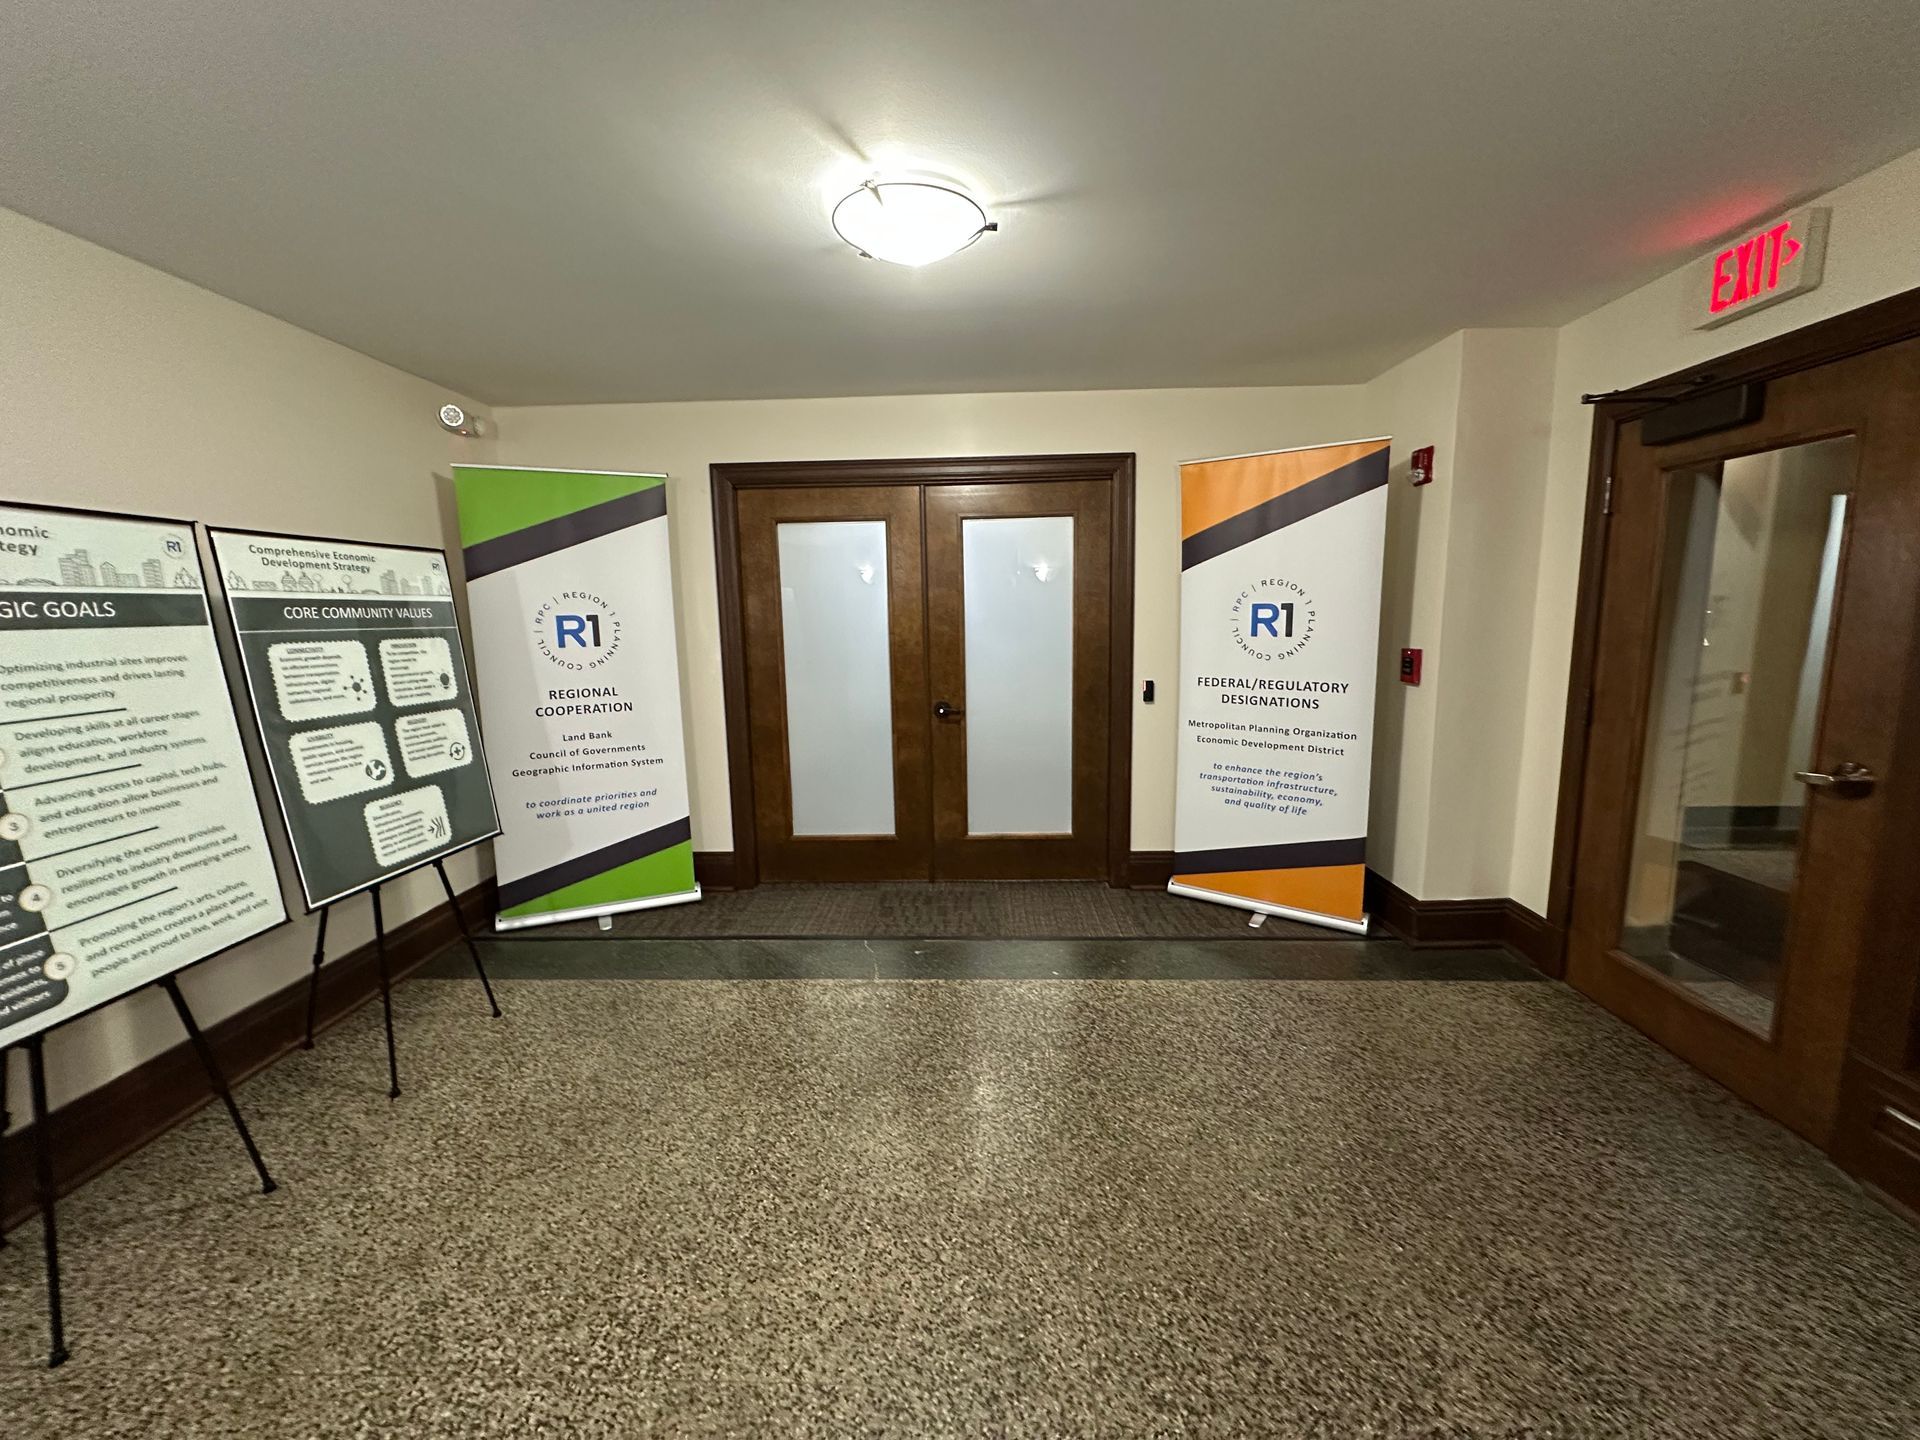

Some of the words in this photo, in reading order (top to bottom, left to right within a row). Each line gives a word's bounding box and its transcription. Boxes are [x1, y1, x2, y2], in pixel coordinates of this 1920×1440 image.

[1709, 220, 1791, 314] EXIT
[249, 544, 330, 560] Comprehensive
[333, 552, 376, 563] Economic
[261, 557, 331, 571] Development
[334, 562, 370, 574] Strategy
[1261, 578, 1305, 596] REGION
[0, 601, 38, 618] GIC
[43, 601, 116, 617] GOALS
[563, 592, 608, 609] REGION
[1232, 591, 1248, 612] RPC
[284, 607, 318, 619] CORE
[322, 607, 393, 619] COMMUNITY
[397, 607, 433, 618] VALUES
[535, 603, 551, 624] RPC
[1250, 602, 1294, 637] R1
[555, 614, 601, 648] R1
[1278, 610, 1316, 660] PLANNING
[538, 639, 583, 670] COUNCIL
[589, 621, 621, 669] PLANNING
[1232, 627, 1271, 661] COUNCIL
[66, 656, 117, 670] industrial
[119, 656, 143, 666] sites
[144, 654, 188, 666] improves
[0, 675, 98, 691] competitiveness
[100, 673, 120, 682] and
[122, 671, 152, 681] drives
[153, 668, 186, 678] lasting
[1197, 676, 1349, 694] FEDERAL/REGULATORY
[5, 693, 56, 708] regional
[59, 689, 116, 704] prosperity
[549, 686, 618, 700] REGIONAL
[1221, 694, 1320, 710] DESIGNATIONS
[535, 702, 633, 717] COOPERATION
[14, 724, 83, 741] Developing
[84, 720, 111, 733] skills
[113, 720, 125, 728] at
[126, 716, 139, 726] all
[140, 714, 169, 724] career
[562, 733, 586, 742] Land
[589, 731, 613, 740] Bank
[1188, 719, 1246, 731] Metropolitan
[1249, 724, 1290, 736] Planning
[1292, 727, 1358, 741] Organization
[19, 744, 55, 759] aligns
[117, 728, 168, 743] workforce
[107, 749, 127, 760] and
[129, 744, 168, 757] industry
[529, 750, 566, 760] Council
[570, 748, 579, 757] of
[582, 744, 646, 756] Governments
[1196, 735, 1239, 746] Economic
[1241, 739, 1305, 752] Development
[1308, 745, 1345, 756] District
[512, 765, 569, 777] Geographic
[572, 760, 628, 772] Information
[631, 757, 664, 768] System
[1213, 762, 1223, 770] to
[1225, 765, 1263, 775] enhance
[1265, 768, 1281, 777] the
[1283, 772, 1323, 782] region's
[34, 788, 95, 807] Advancing
[97, 782, 131, 794] access
[132, 778, 144, 787] to
[180, 766, 201, 776] tech
[1199, 772, 1264, 787] transportation
[1266, 779, 1338, 797] infrastructure,
[39, 811, 62, 823] and
[65, 799, 120, 817] education
[122, 793, 150, 804] allow
[151, 782, 200, 797] businesses
[202, 776, 218, 786] and
[526, 801, 536, 809] to
[539, 796, 592, 808] coordinate
[595, 792, 637, 804] priorities
[640, 788, 657, 797] and
[1211, 785, 1275, 800] sustainability,
[1277, 793, 1323, 806] economy,
[536, 809, 561, 819] work
[586, 804, 617, 814] united
[620, 800, 650, 812] region
[1224, 797, 1241, 806] and
[1243, 800, 1277, 812] quality
[1278, 805, 1290, 814] of
[1291, 806, 1308, 816] life
[9, 822, 19, 831] 3
[43, 814, 124, 839] entrepreneurs
[126, 810, 138, 818] to
[139, 800, 181, 814] innovate
[56, 855, 123, 879] Diversifying
[124, 849, 142, 859] the
[143, 836, 186, 852] economy
[61, 871, 116, 894] resilience
[117, 868, 129, 876] to
[130, 855, 170, 873] industry
[172, 840, 220, 860] downturns
[222, 833, 237, 844] and
[66, 884, 130, 909] encourages
[131, 870, 168, 890] growth
[169, 867, 178, 875] in
[179, 854, 221, 873] emerging
[222, 845, 252, 858] sectors
[79, 920, 137, 948] Promoting
[138, 914, 156, 925] the
[86, 949, 107, 963] and
[109, 930, 162, 952] recreation
[163, 915, 198, 931] creates
[206, 901, 228, 917] place
[91, 956, 129, 978] people
[131, 949, 149, 960] are
[150, 937, 179, 954] proud
[181, 932, 191, 940] to
[237, 905, 252, 917] and
